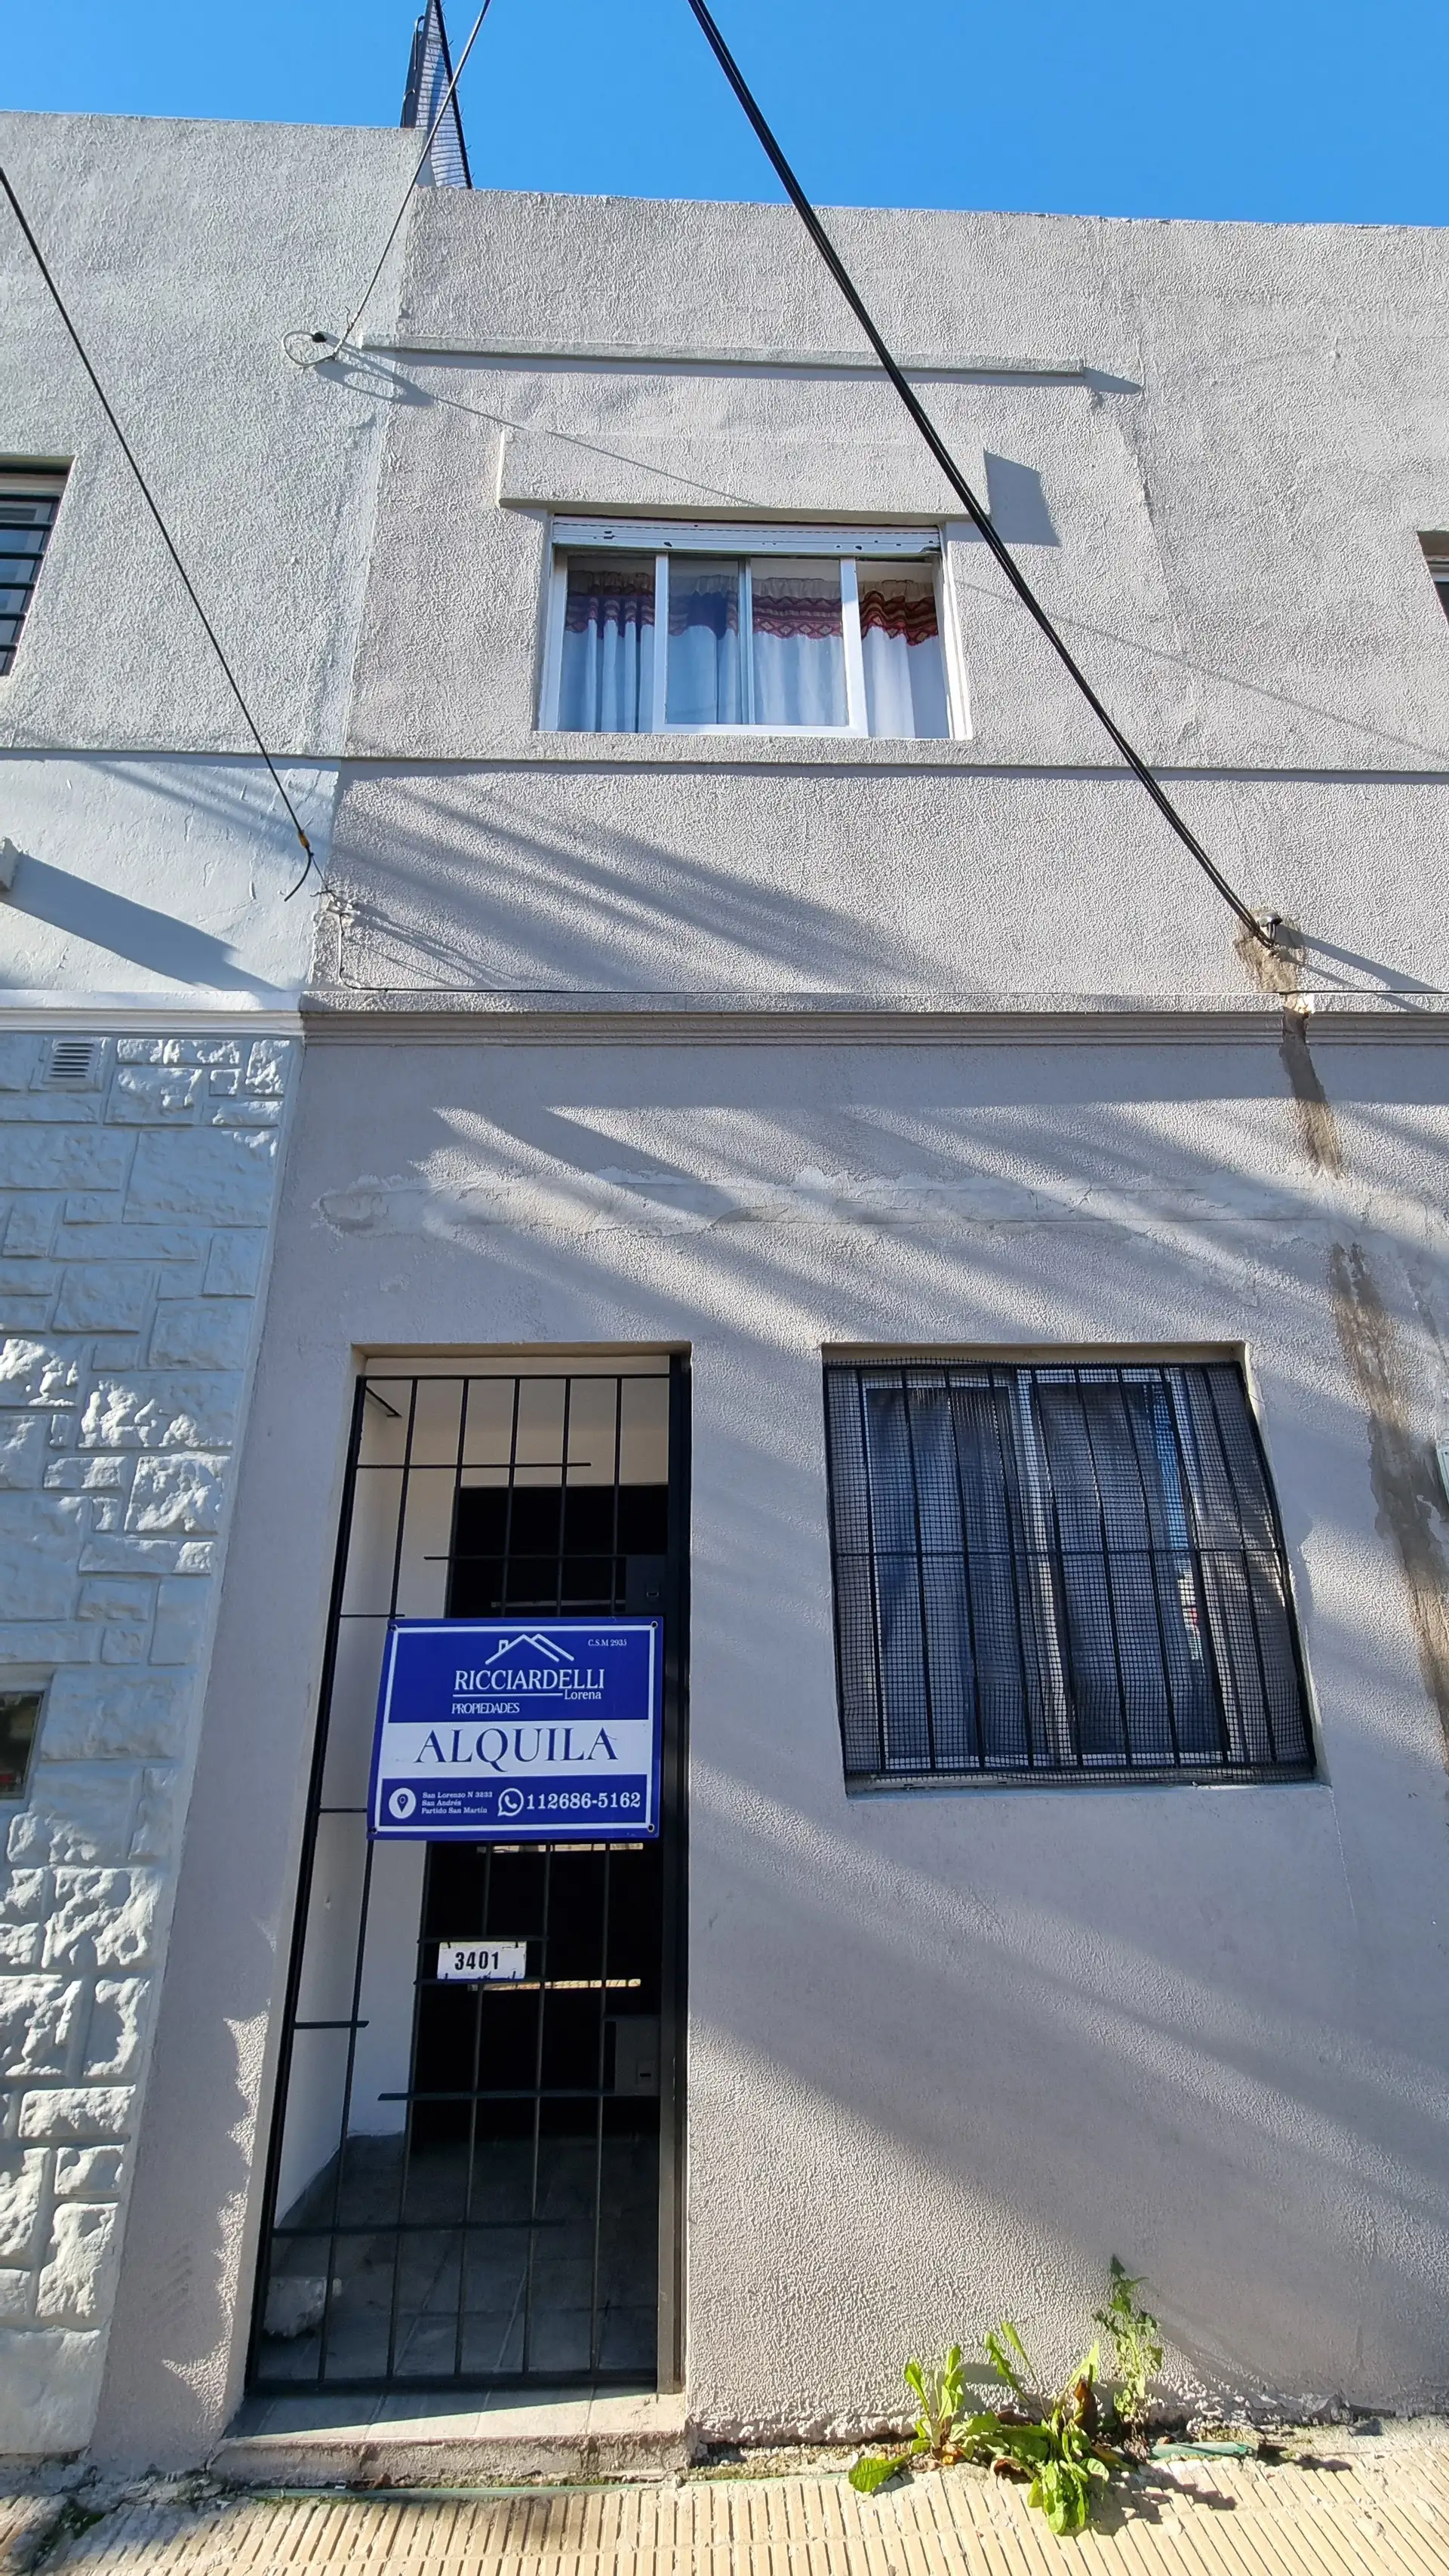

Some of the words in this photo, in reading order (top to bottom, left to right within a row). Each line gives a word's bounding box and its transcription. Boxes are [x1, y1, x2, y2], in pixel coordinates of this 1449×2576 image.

[454, 1669, 605, 1690] RICCIARDELLI
[565, 1688, 601, 1700] Lorena
[451, 1702, 520, 1714] PROPIEDADES
[413, 1727, 619, 1772] ALQUILA
[526, 1792, 641, 1809] 112686-5162
[454, 1951, 498, 1971] 3401
